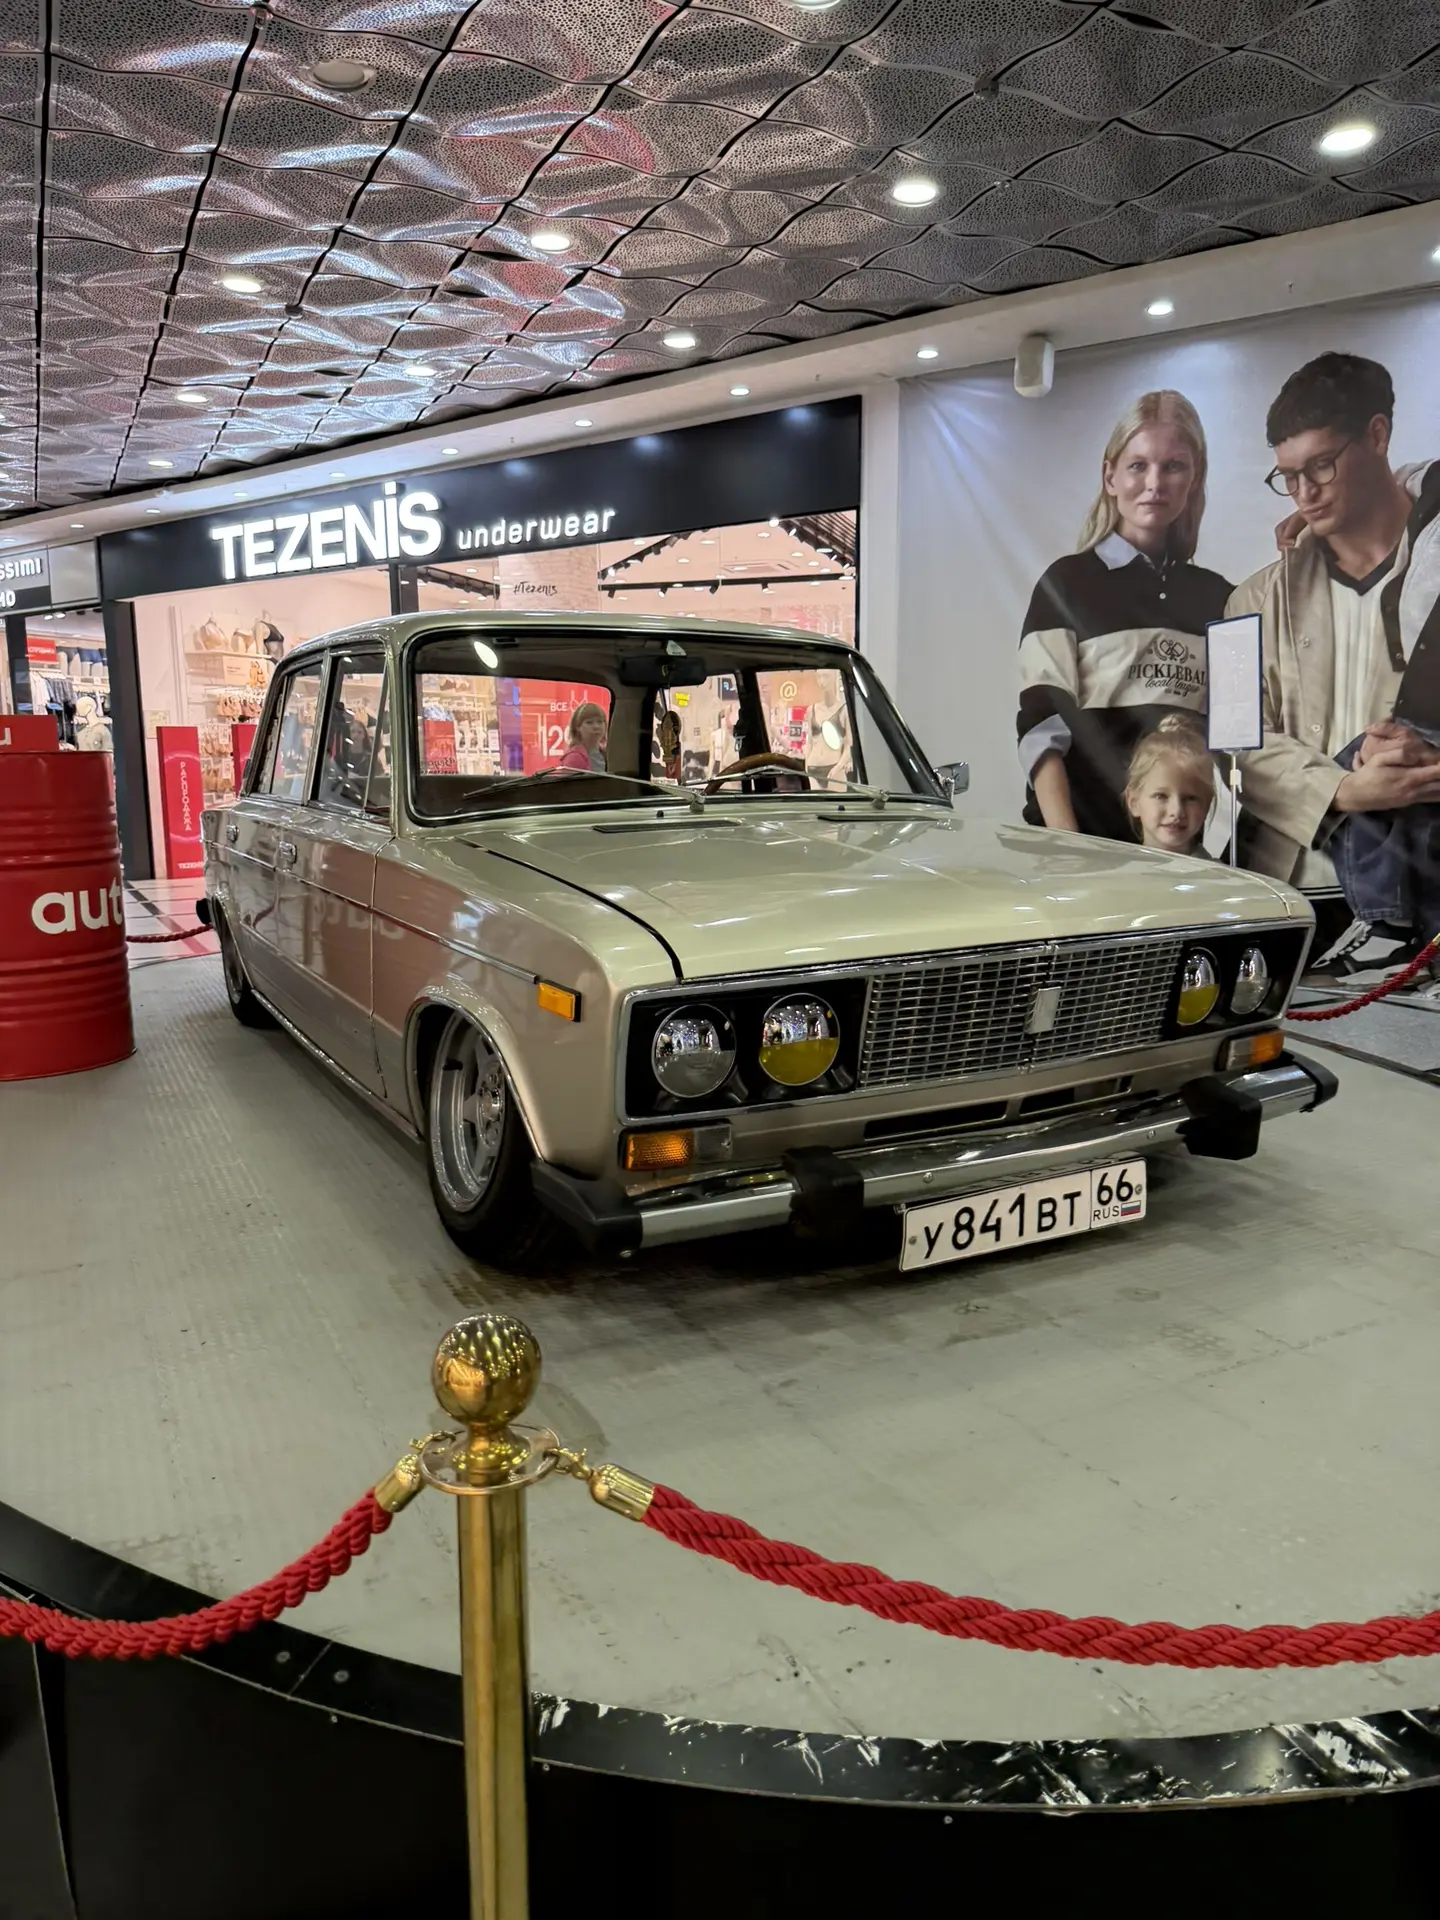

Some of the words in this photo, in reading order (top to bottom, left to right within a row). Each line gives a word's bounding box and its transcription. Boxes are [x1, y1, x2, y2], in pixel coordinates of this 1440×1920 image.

[457, 508, 615, 551] underwear
[540, 724, 572, 757] 12
[1096, 1168, 1134, 1206] 66
[1092, 1205, 1120, 1221] RUS
